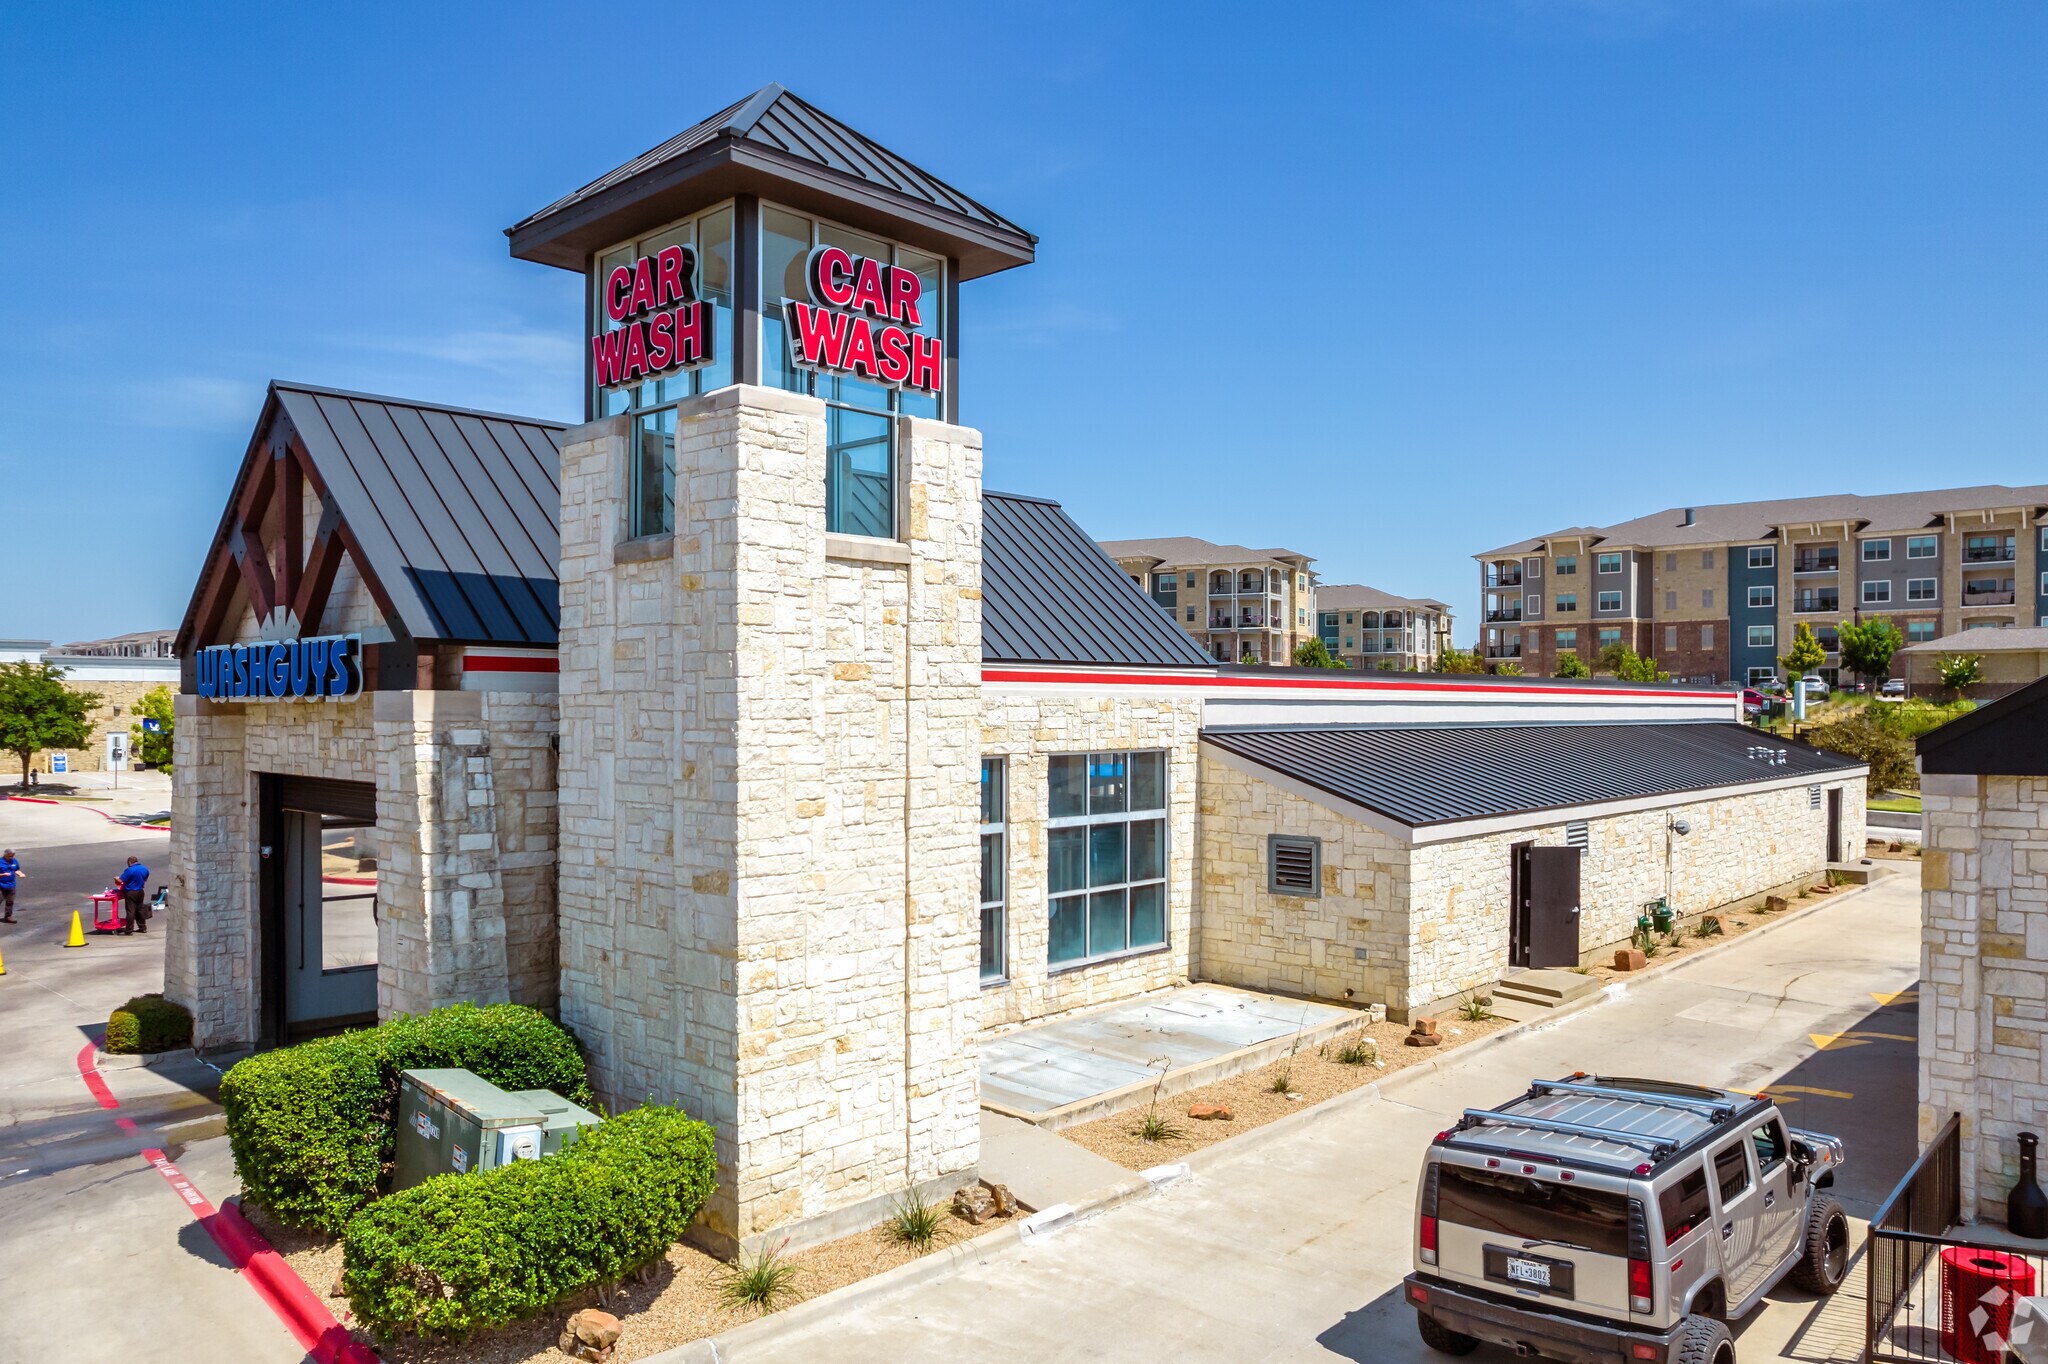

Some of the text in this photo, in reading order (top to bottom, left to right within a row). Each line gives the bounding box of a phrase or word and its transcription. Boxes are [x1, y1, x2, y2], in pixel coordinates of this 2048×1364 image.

[606, 244, 684, 322] CAR
[818, 247, 923, 327] CAR
[592, 301, 702, 388] WASH
[795, 302, 943, 392] WASH
[196, 639, 349, 699] WASHGUYS
